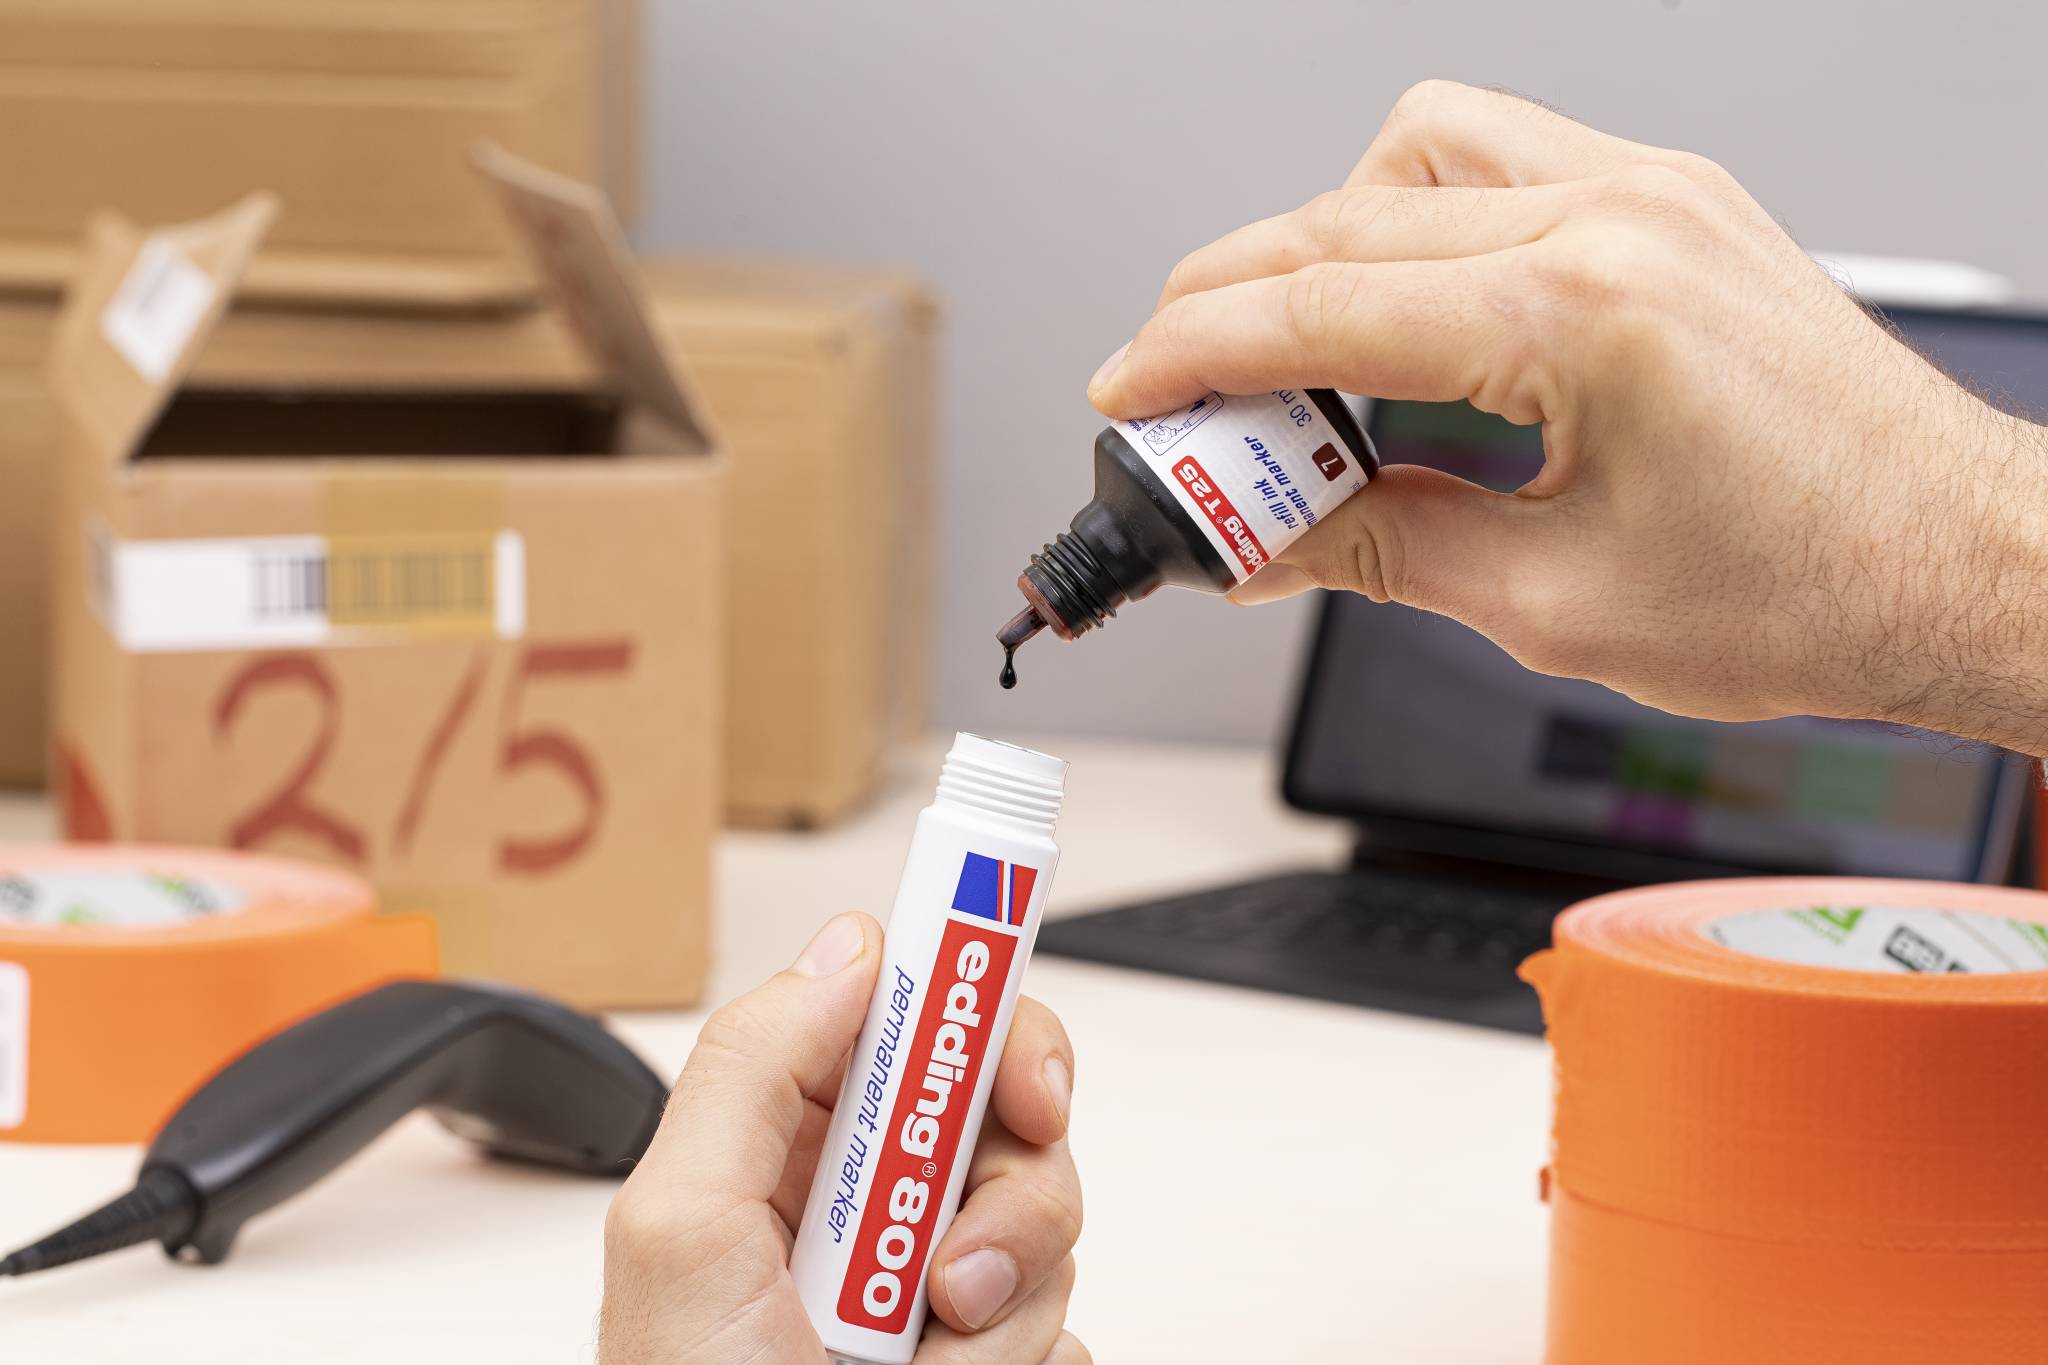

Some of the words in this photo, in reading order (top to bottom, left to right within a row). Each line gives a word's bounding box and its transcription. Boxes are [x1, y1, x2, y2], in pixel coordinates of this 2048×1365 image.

[1290, 405, 1312, 428] 30
[1243, 436, 1291, 486] marker
[1321, 457, 1339, 472] 7
[1178, 463, 1212, 498] 25
[1252, 478, 1279, 501] ink
[1203, 498, 1221, 515] T
[1268, 501, 1299, 530] refill
[212, 638, 636, 876] 2/5
[857, 965, 915, 1134] permanent
[827, 1134, 868, 1244] marker
[863, 1176, 930, 1318] 800
